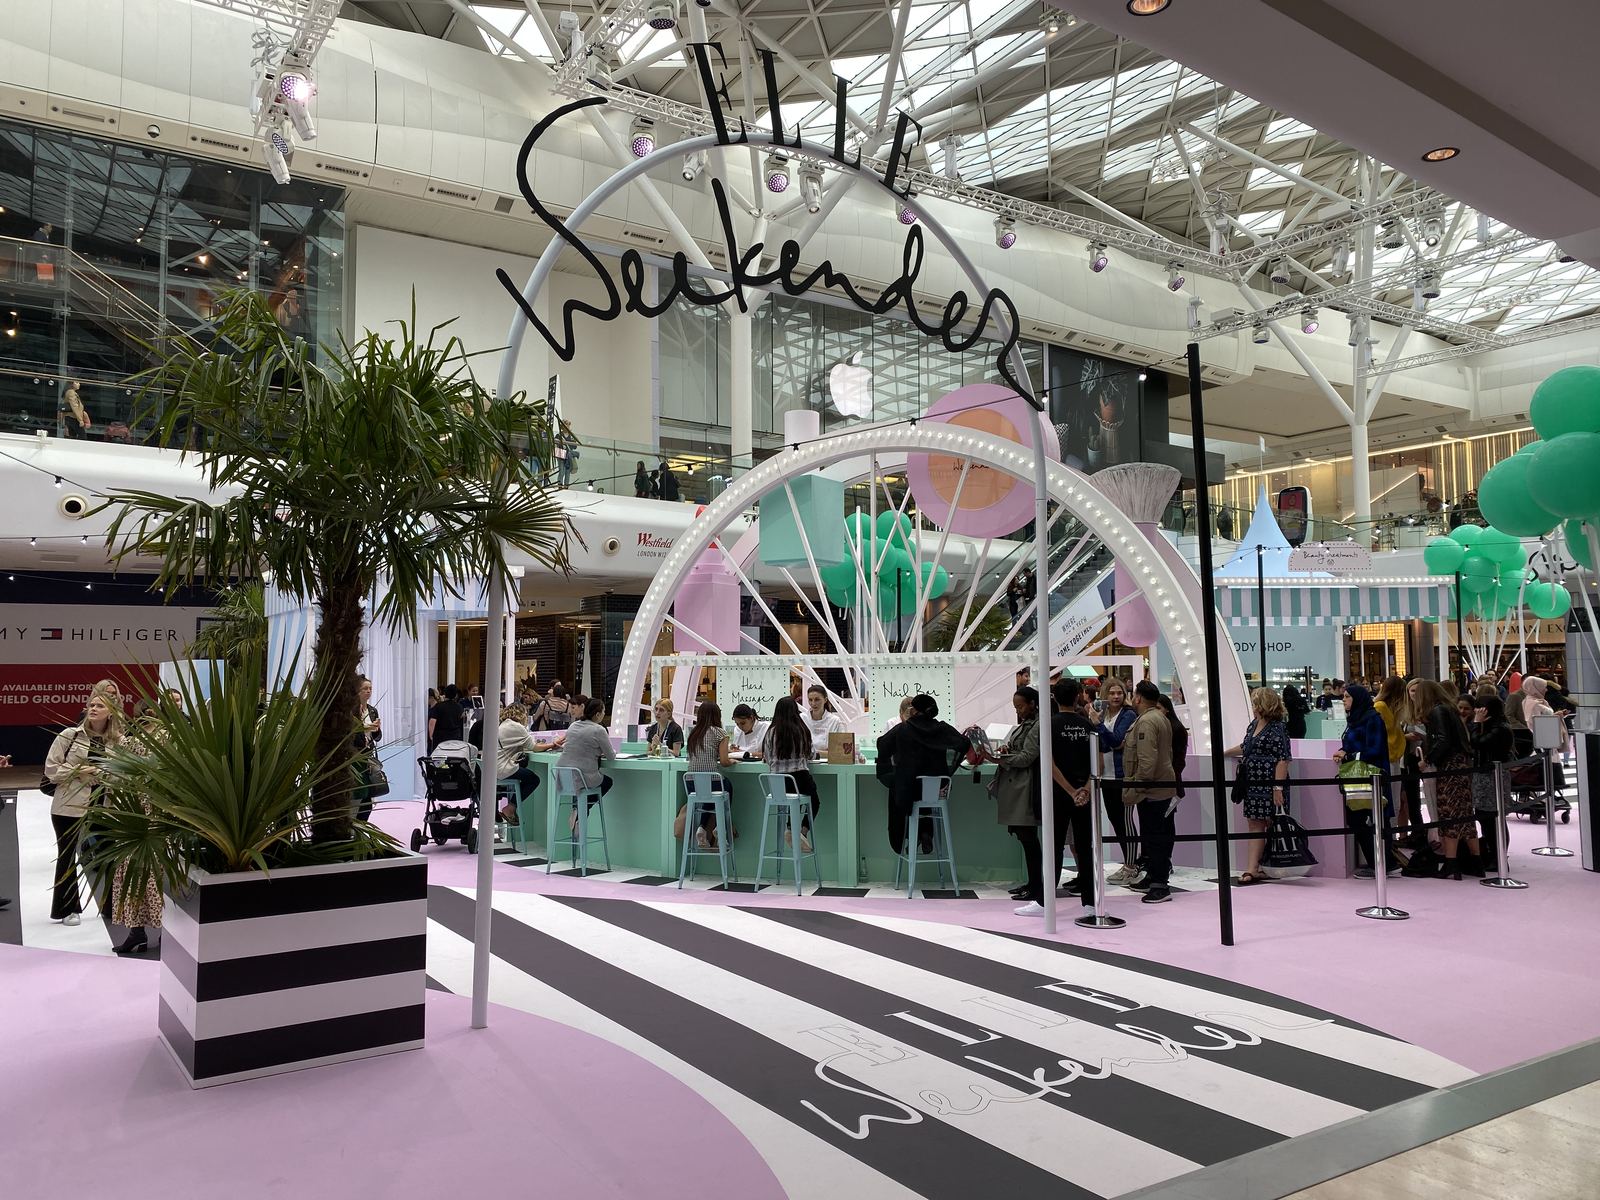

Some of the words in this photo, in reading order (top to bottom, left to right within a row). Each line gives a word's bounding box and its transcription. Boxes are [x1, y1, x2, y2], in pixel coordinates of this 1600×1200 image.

[687, 42, 923, 200] ELLE
[637, 532, 674, 549] Westfield
[1303, 551, 1324, 564] Beauty
[72, 628, 178, 641] HILFIGER
[1057, 644, 1070, 657] COME
[1234, 642, 1256, 652] ODY
[1264, 642, 1292, 652] HOP
[741, 676, 764, 691] Hand
[883, 681, 908, 698] Nail
[914, 683, 940, 697] Bar
[32, 694, 89, 704] GROUND
[731, 690, 775, 713] Massages
